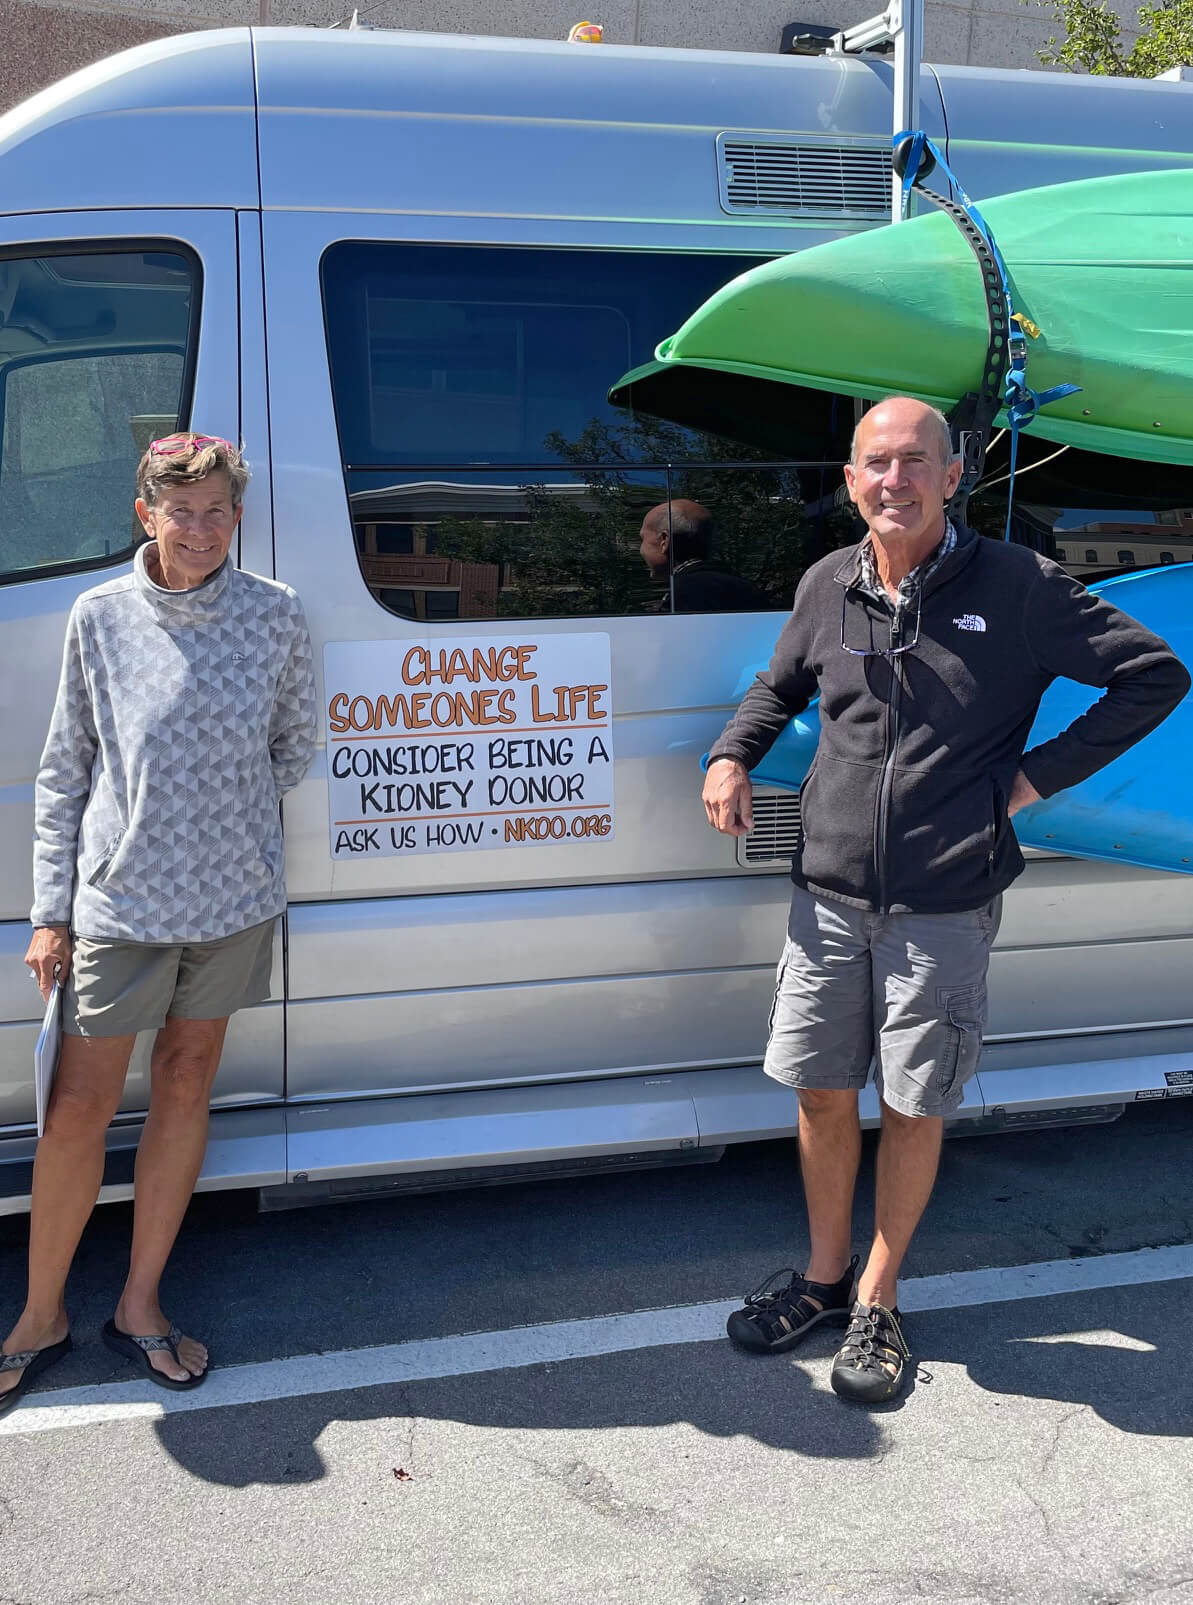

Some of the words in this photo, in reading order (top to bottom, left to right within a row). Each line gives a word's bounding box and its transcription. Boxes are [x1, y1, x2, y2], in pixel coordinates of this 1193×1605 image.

[402, 645, 537, 686] CHANGE
[329, 688, 517, 732] SOMEONES
[531, 684, 608, 722] LIFE
[332, 742, 475, 779] CONSIDER
[488, 737, 573, 769] BEING
[588, 736, 610, 764] A
[360, 779, 474, 814] KIDNEY
[488, 773, 585, 806] DONOR
[335, 828, 380, 854] ASK
[390, 825, 417, 849] US
[426, 821, 484, 847] HOW
[504, 814, 611, 842] NKDO.ORG
